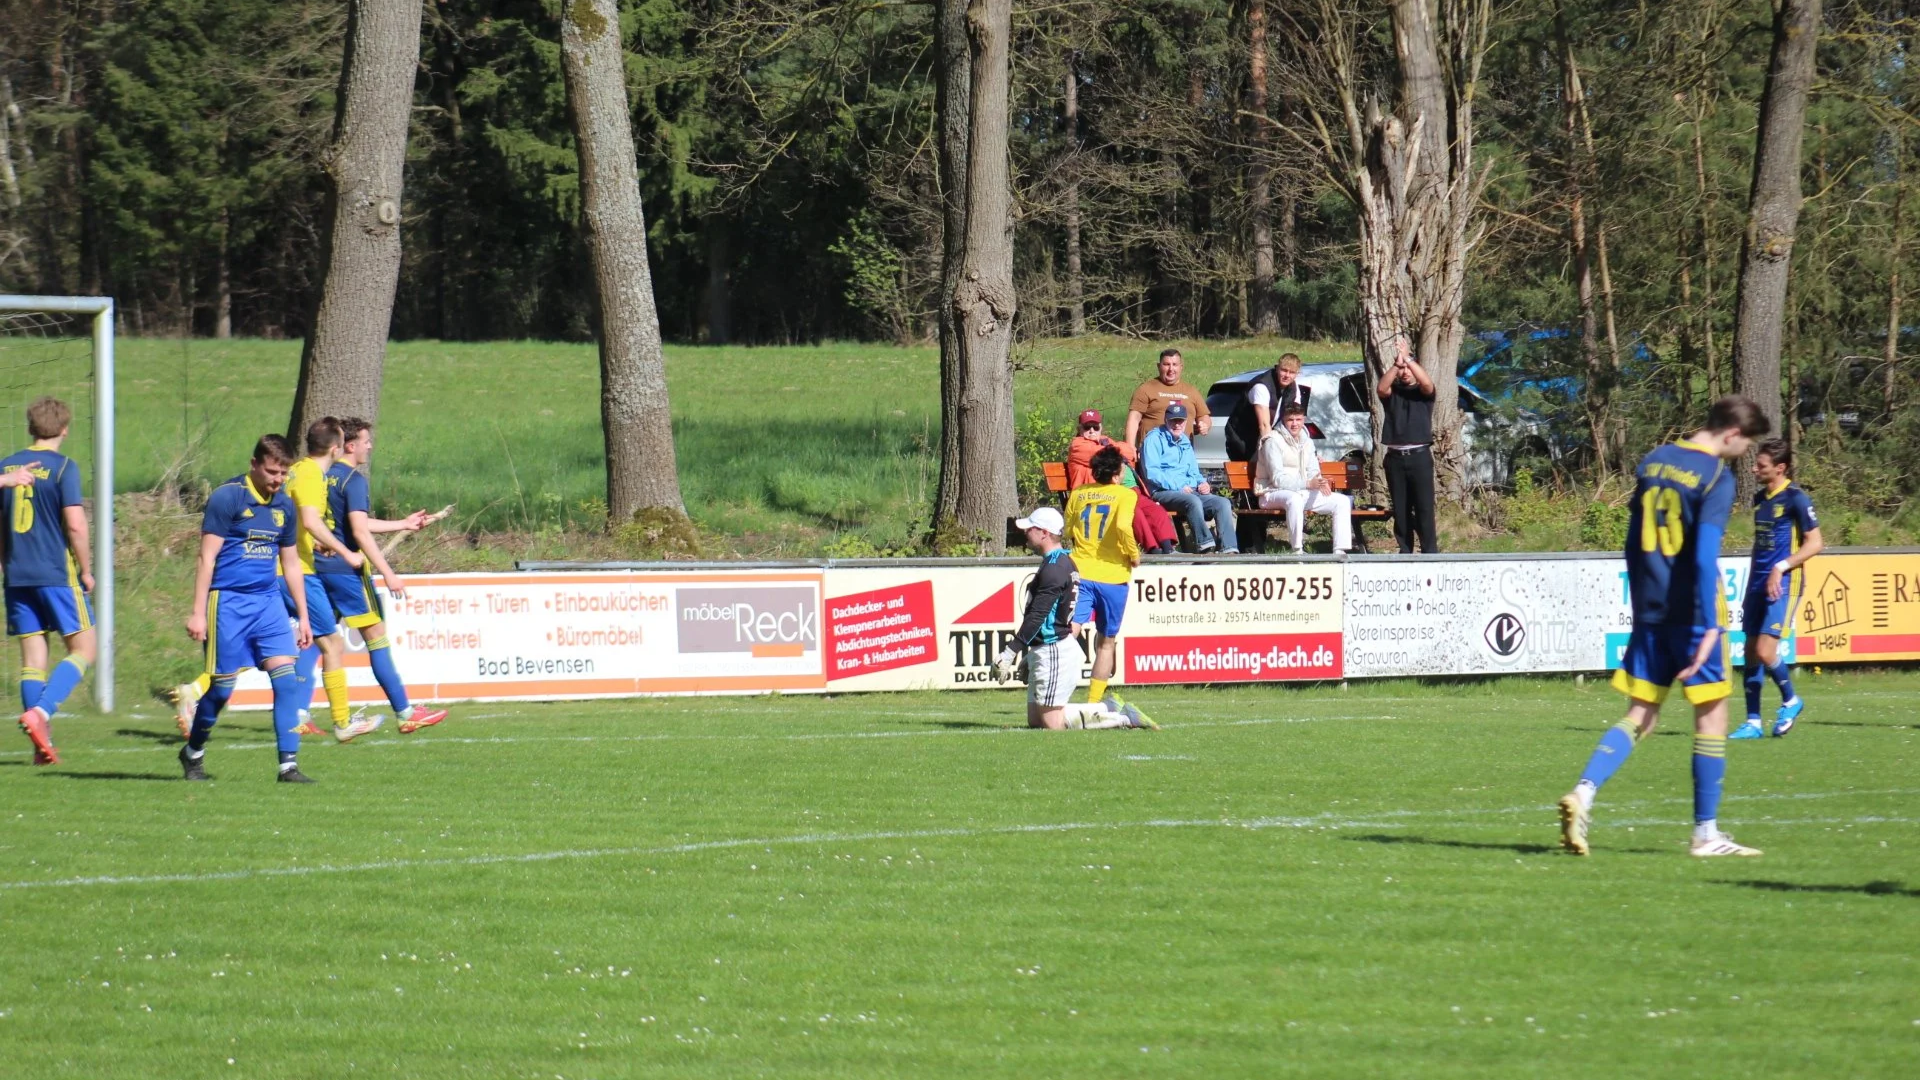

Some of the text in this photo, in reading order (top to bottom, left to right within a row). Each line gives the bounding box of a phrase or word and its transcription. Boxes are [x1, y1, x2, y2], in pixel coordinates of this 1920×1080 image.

[14, 484, 34, 534] 6
[1641, 485, 1684, 556] 13
[1080, 503, 1110, 539] 17
[1134, 577, 1332, 602] Telefon 05807-255
[1351, 574, 1471, 598] Augenoptik Uhren
[405, 595, 463, 615] Fenster
[486, 593, 530, 614] Türen
[555, 591, 669, 612] Einbauküchen
[832, 595, 904, 619] Dachdecker- und
[1351, 598, 1457, 617] Schmuck Pokale
[683, 602, 816, 642] möbel Reck
[833, 613, 912, 636] Klempnerarbeiten
[1149, 610, 1320, 626] Hauptstraße 32 29575 Altenmedingen
[406, 628, 482, 649] Tischlerei
[556, 624, 644, 646] Büromöbel
[836, 627, 933, 653] Abdichtungstechniken,
[1351, 623, 1435, 645] Vereinspreise
[1819, 633, 1847, 652] Haus
[478, 656, 594, 676] Bad Bevensen
[837, 658, 862, 670] Kran-
[872, 645, 925, 663] Hubarbeiten
[1134, 645, 1333, 675] www.theiding-dach.de
[1352, 647, 1408, 665] Gravuren
